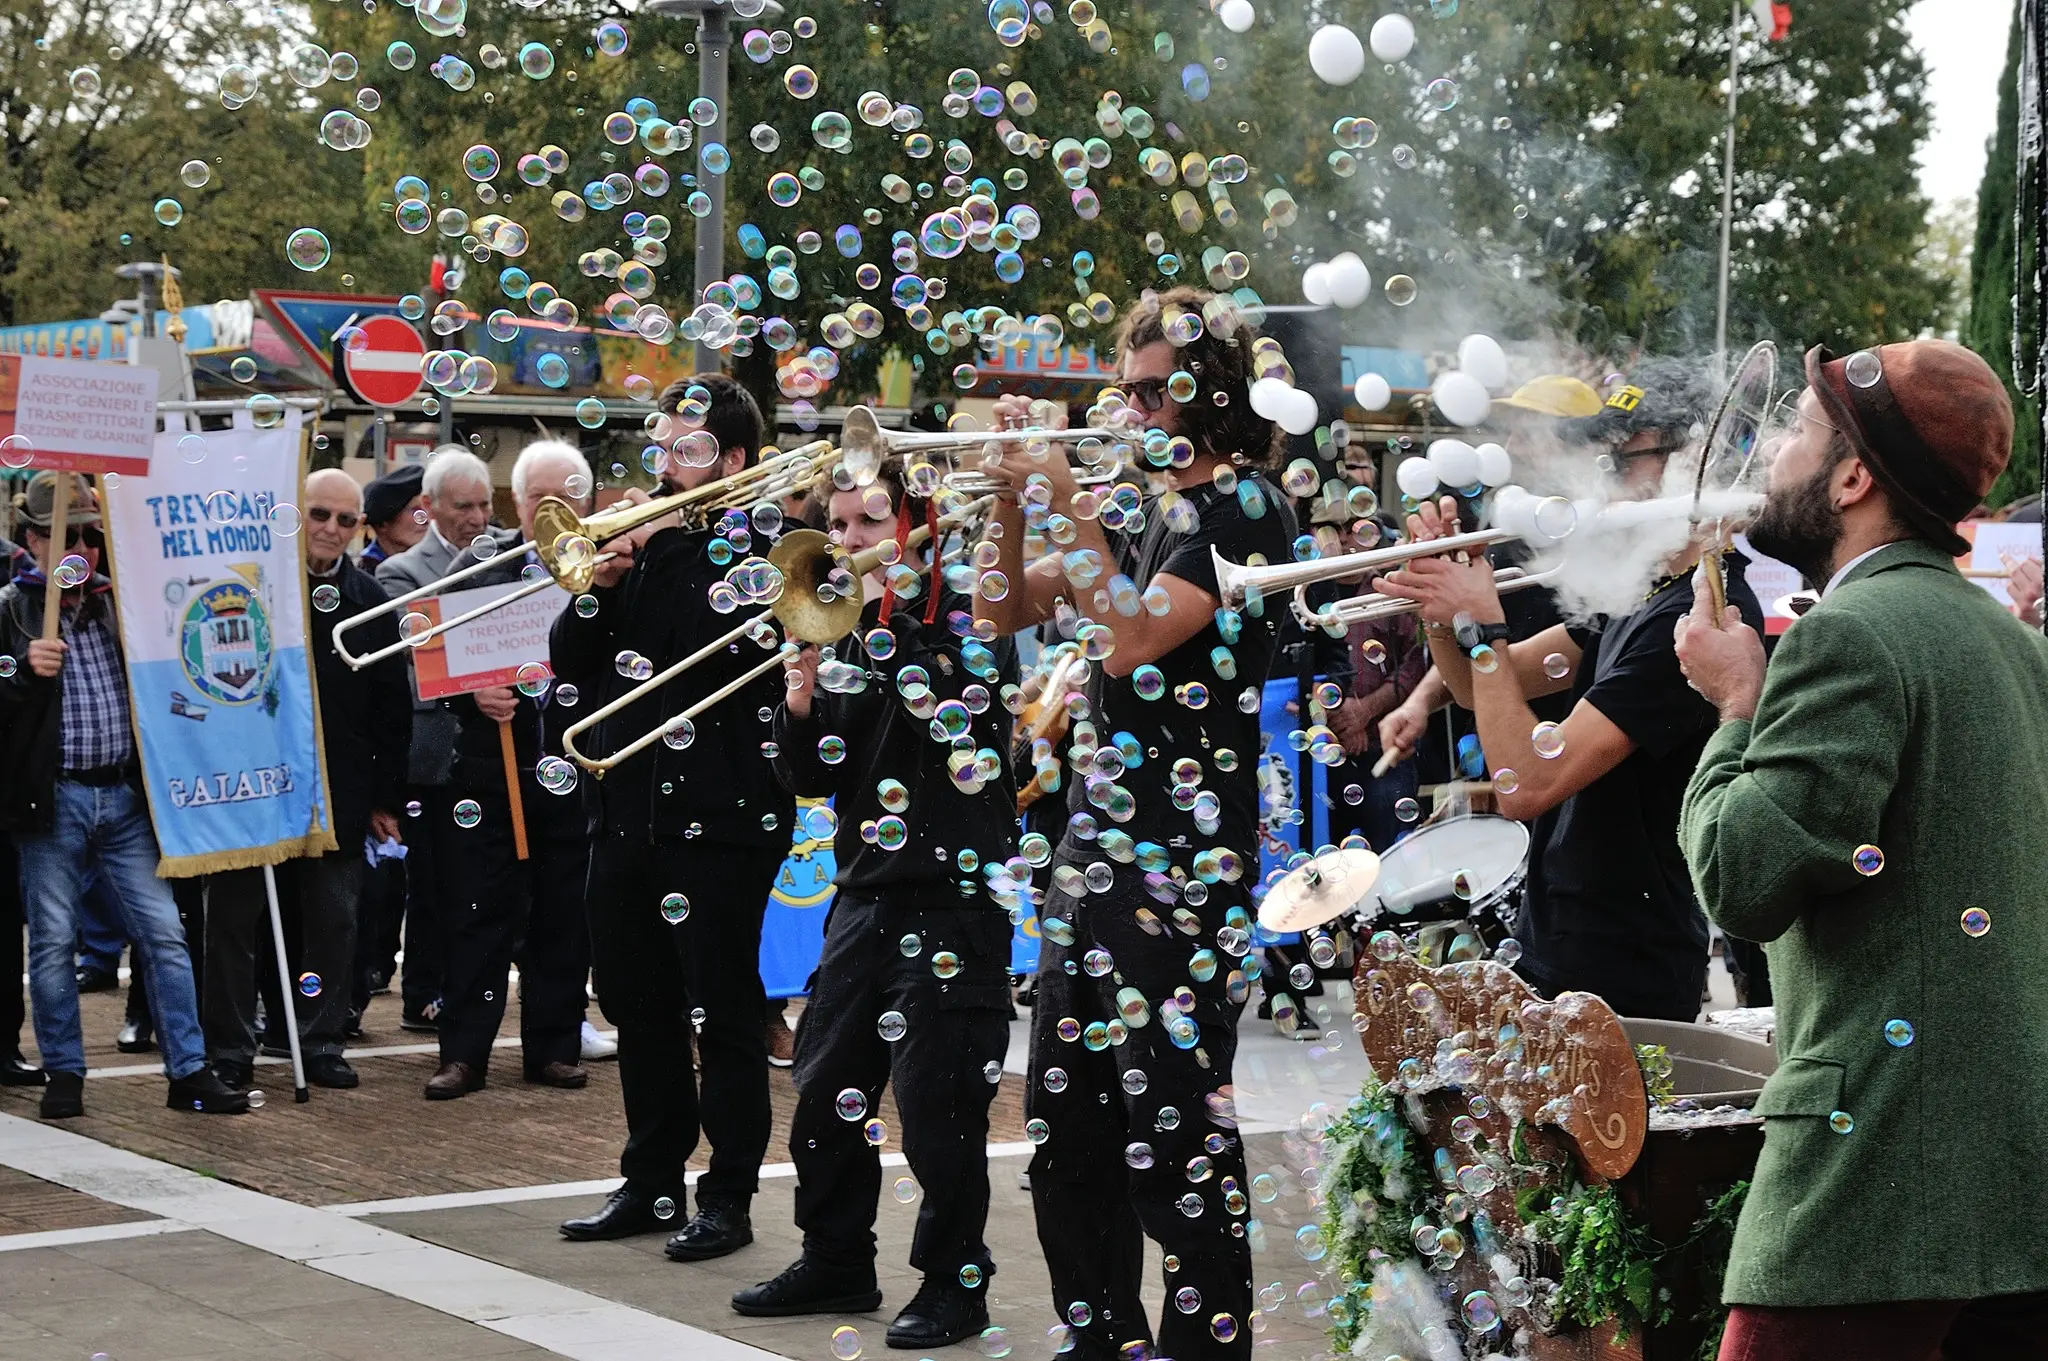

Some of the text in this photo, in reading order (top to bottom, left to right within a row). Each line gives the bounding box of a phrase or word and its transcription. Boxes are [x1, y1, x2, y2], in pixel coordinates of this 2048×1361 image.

[31, 373, 146, 396] ASSOCIAZIONE
[21, 390, 153, 414] ANGET-GENIERI E
[25, 407, 145, 429] TRASMETTITORI
[18, 423, 149, 446] SEZIONE GAIARINE
[146, 490, 277, 528] TREVISANI
[161, 524, 272, 559] NEL MONDO
[466, 598, 561, 623] OCIAZIONE
[468, 617, 547, 640] TREVISANI
[465, 643, 494, 657] NEL
